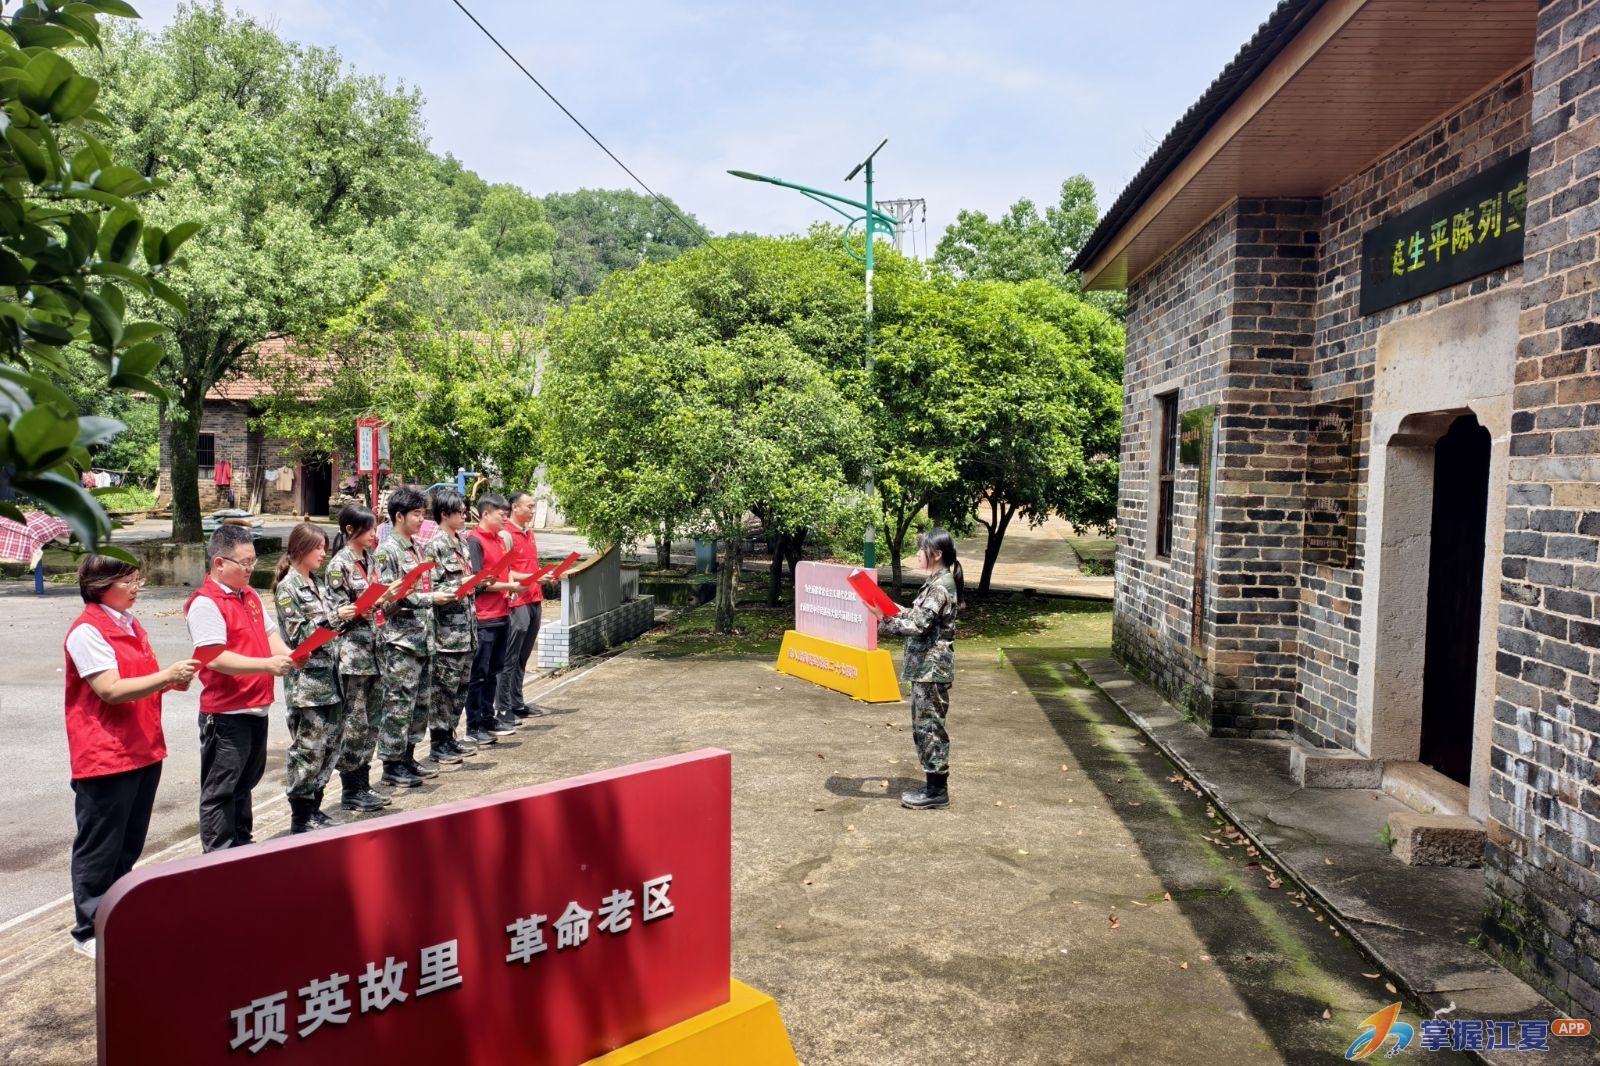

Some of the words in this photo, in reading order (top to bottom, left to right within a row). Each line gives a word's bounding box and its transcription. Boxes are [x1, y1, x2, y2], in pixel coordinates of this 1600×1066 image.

[229, 939, 463, 1053] 项英故里
[505, 874, 675, 964] 革命老区
